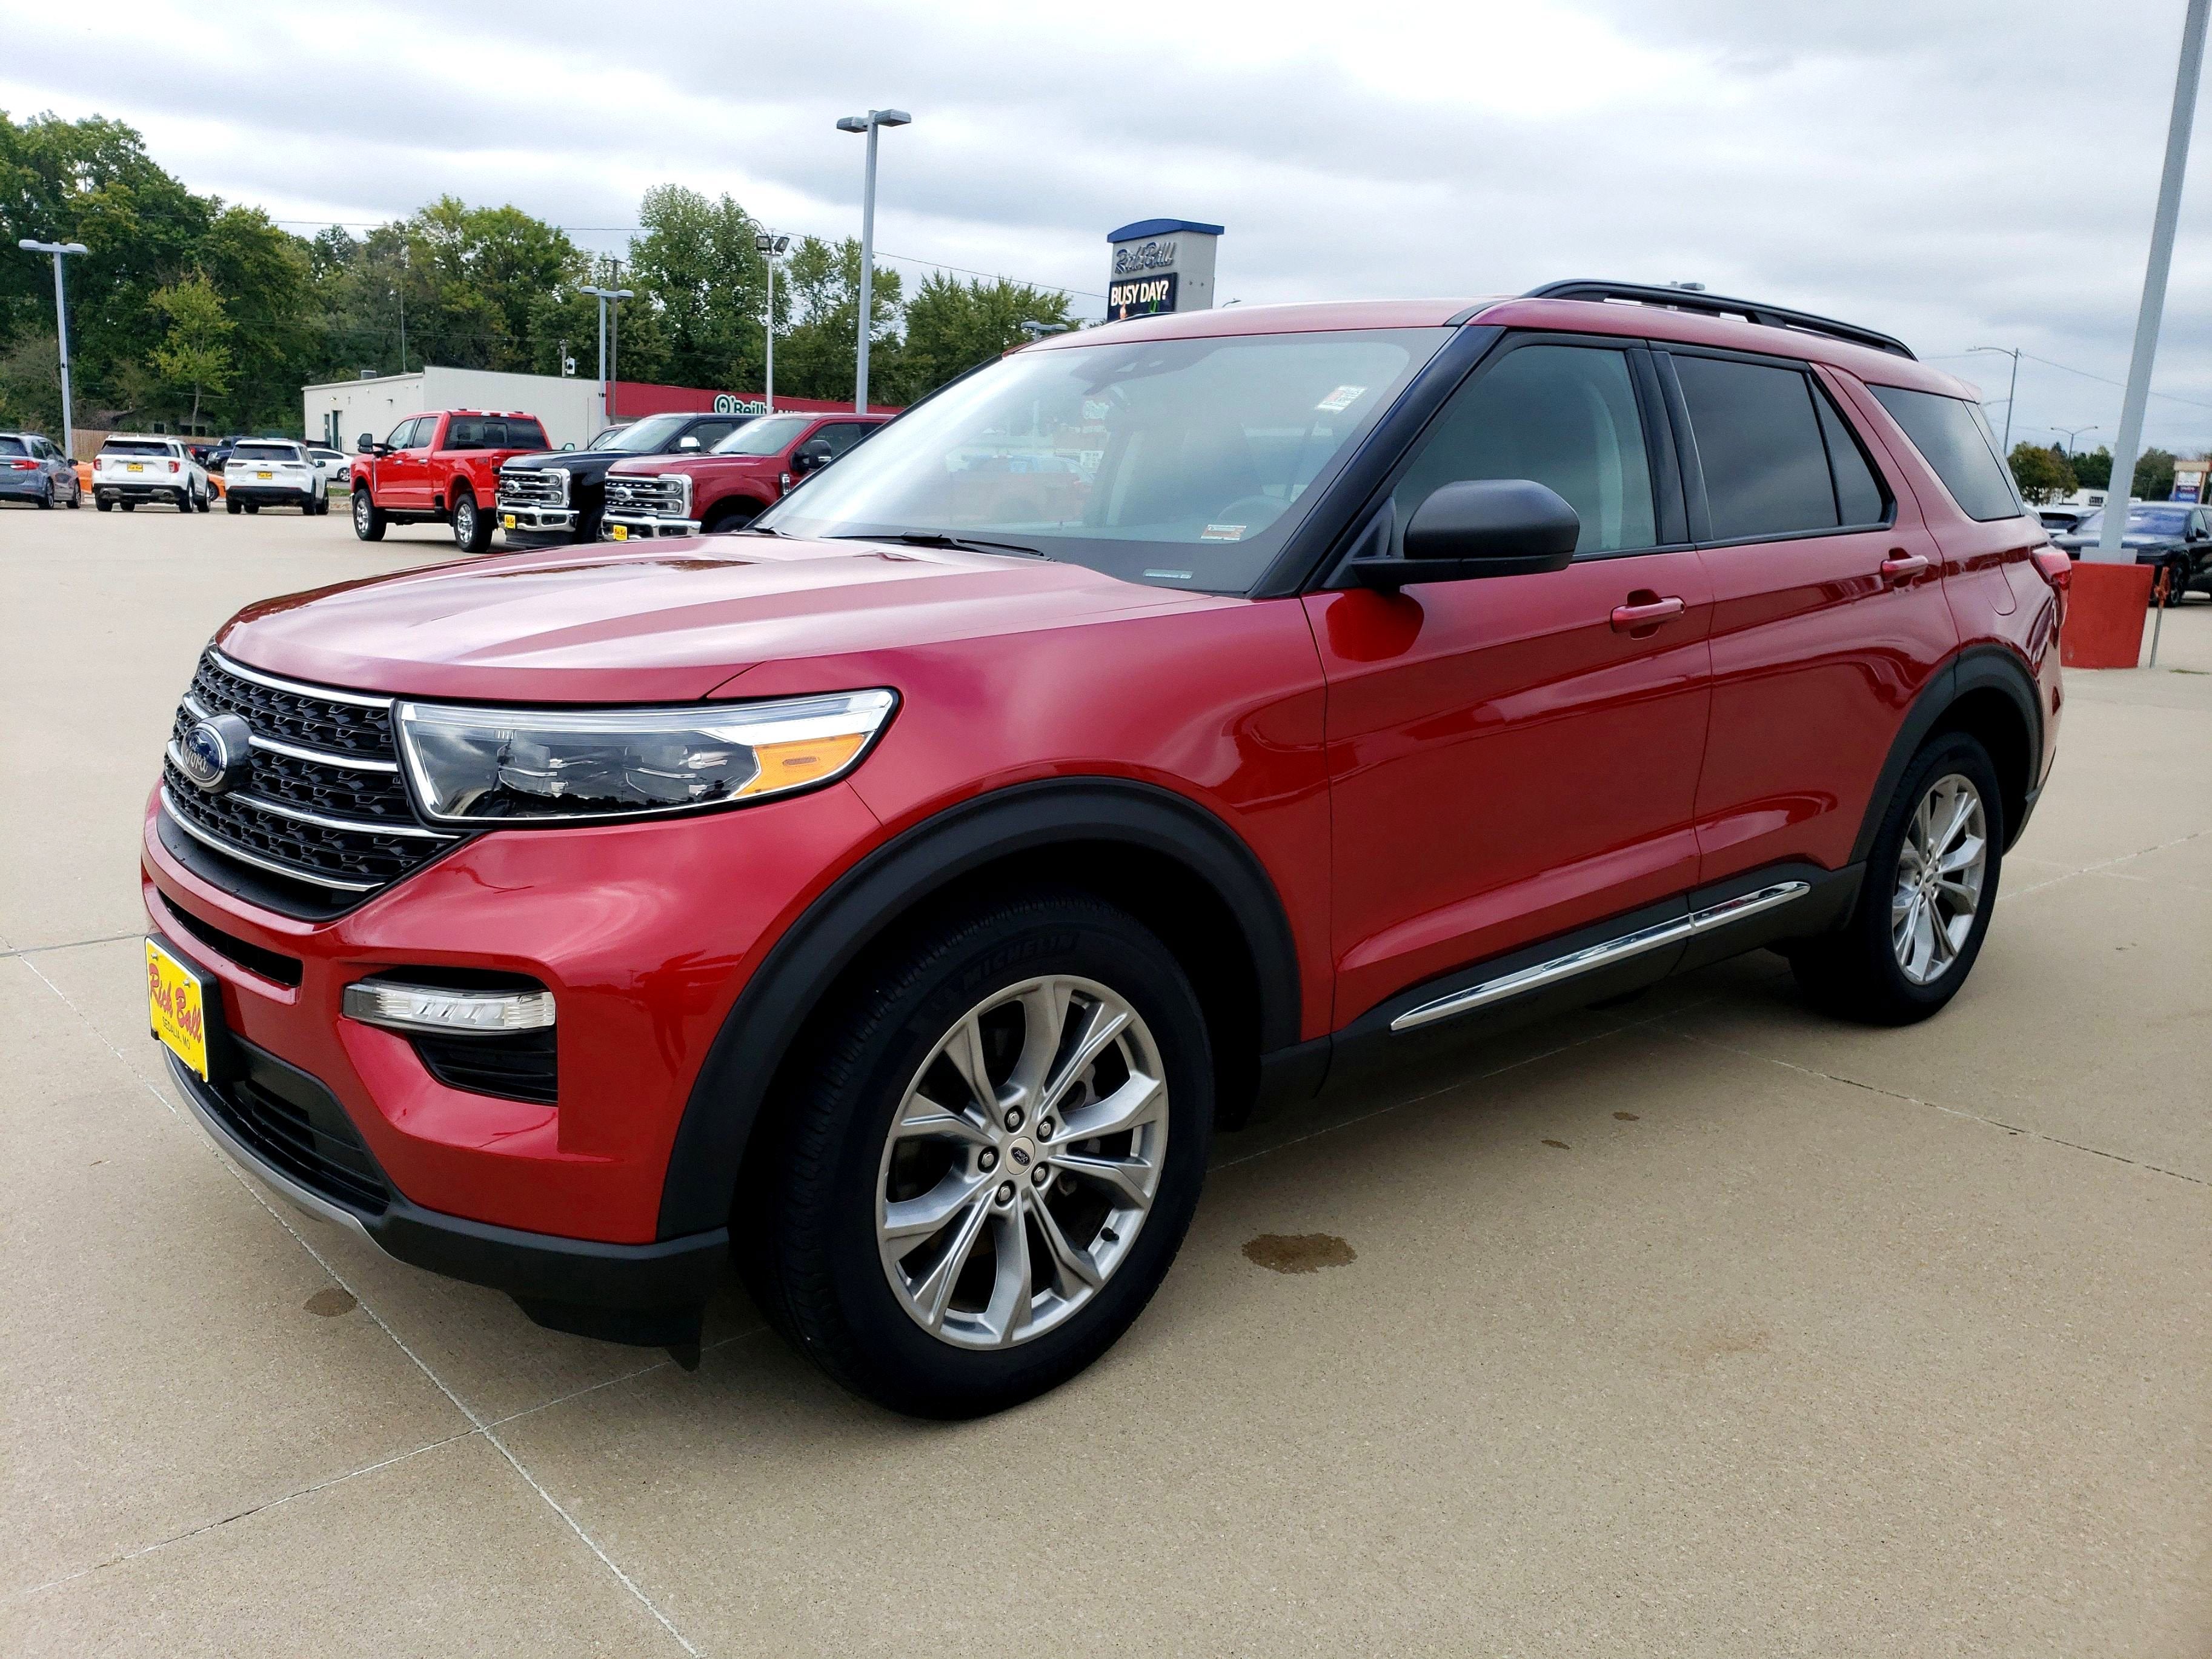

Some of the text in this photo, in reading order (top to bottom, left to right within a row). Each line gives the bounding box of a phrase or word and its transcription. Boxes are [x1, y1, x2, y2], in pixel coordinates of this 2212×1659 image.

[1111, 280, 1169, 307] BUSY DAY?
[149, 963, 202, 1043] Rick Ball
